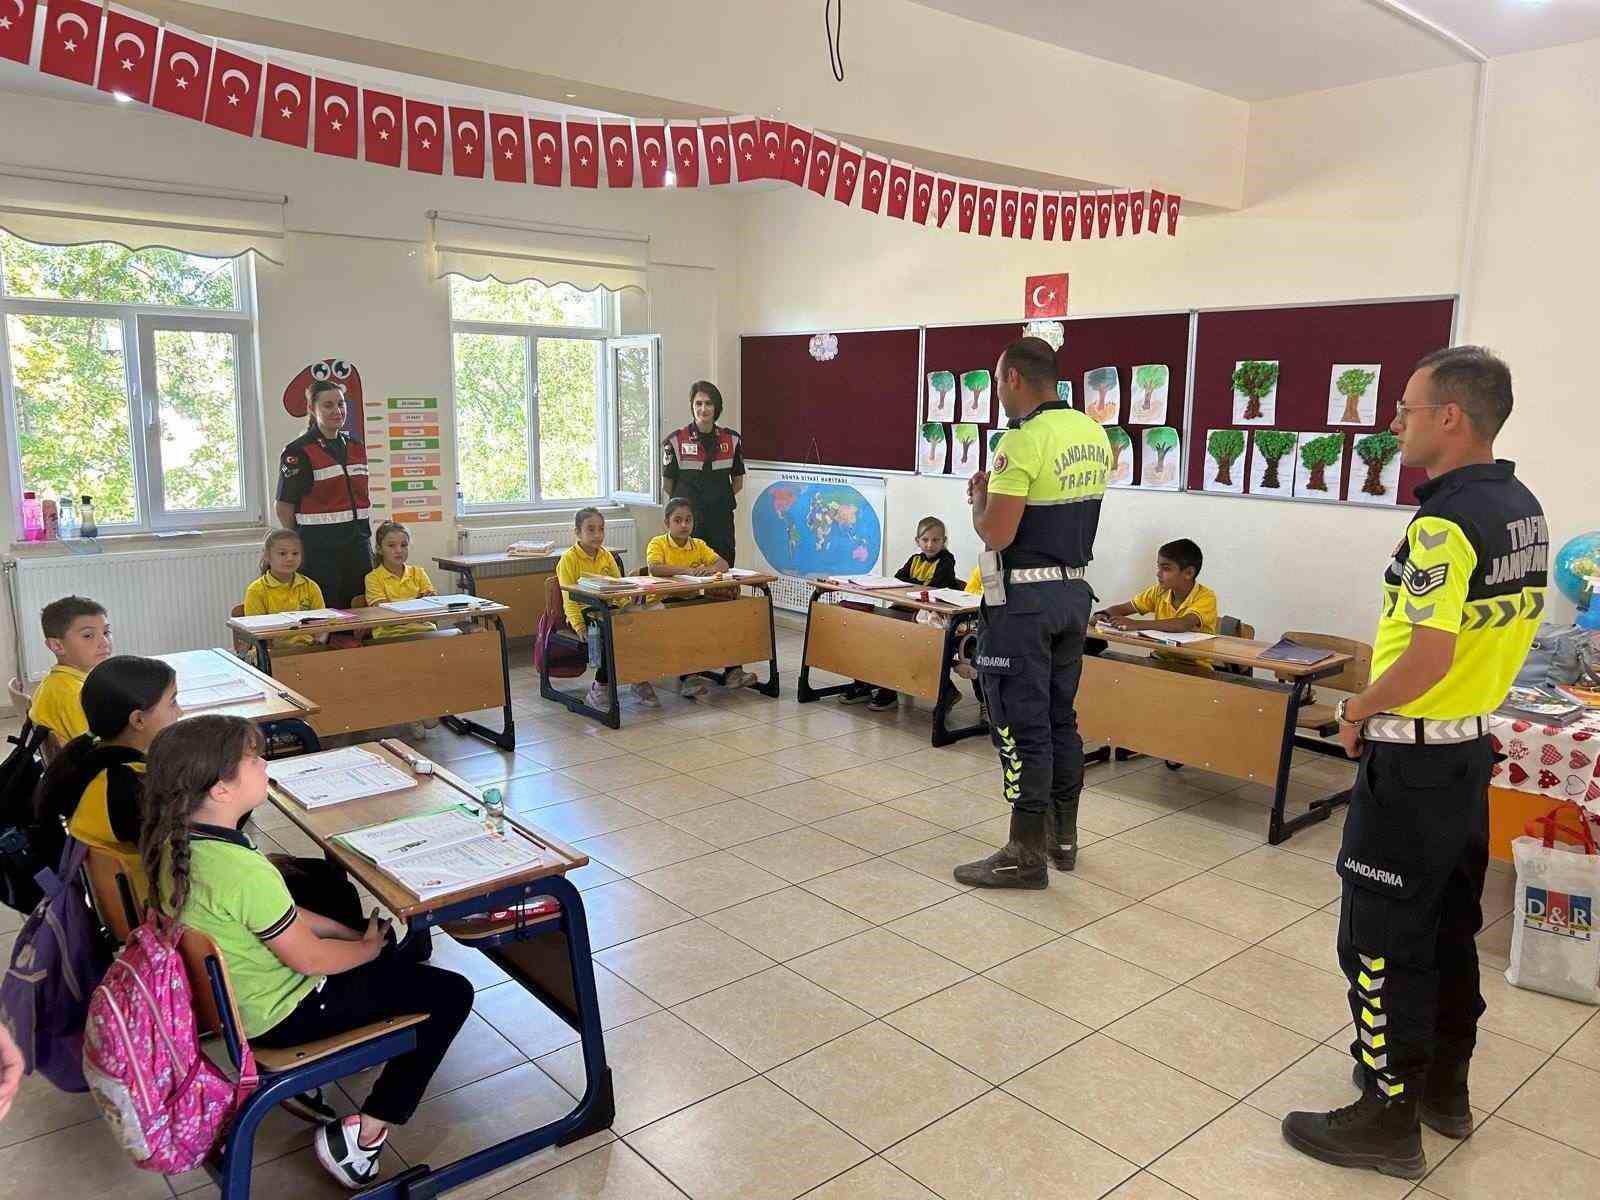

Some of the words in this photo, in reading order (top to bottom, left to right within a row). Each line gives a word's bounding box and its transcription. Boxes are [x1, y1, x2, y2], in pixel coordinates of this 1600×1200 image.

[1054, 444, 1109, 476] JANDARMA
[1344, 857, 1403, 888] JANDARMA
[1527, 898, 1588, 927] D&R
